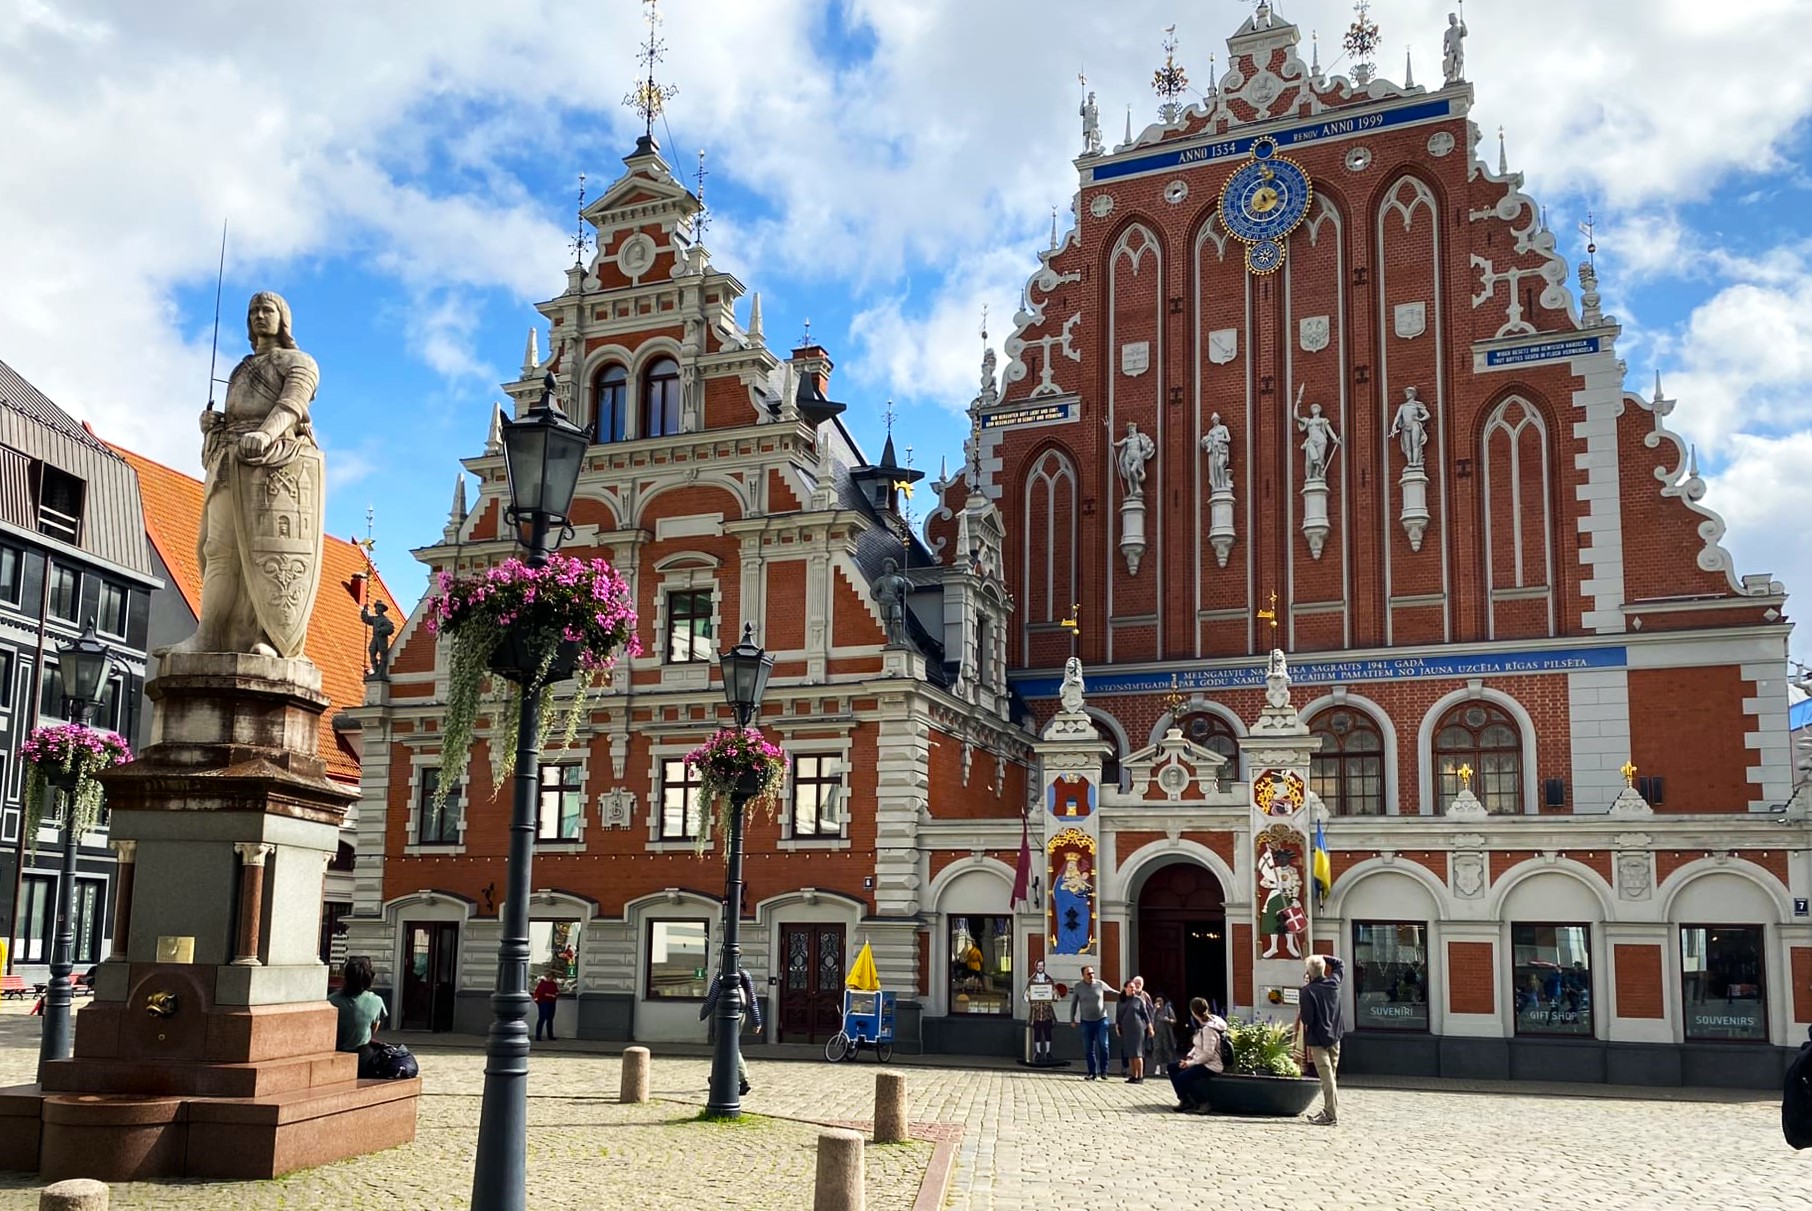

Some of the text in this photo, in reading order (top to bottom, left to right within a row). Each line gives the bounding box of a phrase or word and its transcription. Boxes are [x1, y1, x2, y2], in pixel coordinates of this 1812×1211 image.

[1293, 113, 1384, 141] RENOV ANNO 1999
[1178, 142, 1237, 163] ANNO 1334
[1311, 663, 1362, 673] SAGRAUTS
[1199, 678, 1229, 687] GODU
[1232, 676, 1263, 685] NAMU
[1341, 669, 1393, 679] PAMATIEM
[1398, 667, 1415, 676] NO
[1420, 666, 1454, 676] JAUNA
[1530, 1011, 1577, 1021] GIFT SHOP
[1695, 1015, 1754, 1026] SOUVENIRS
